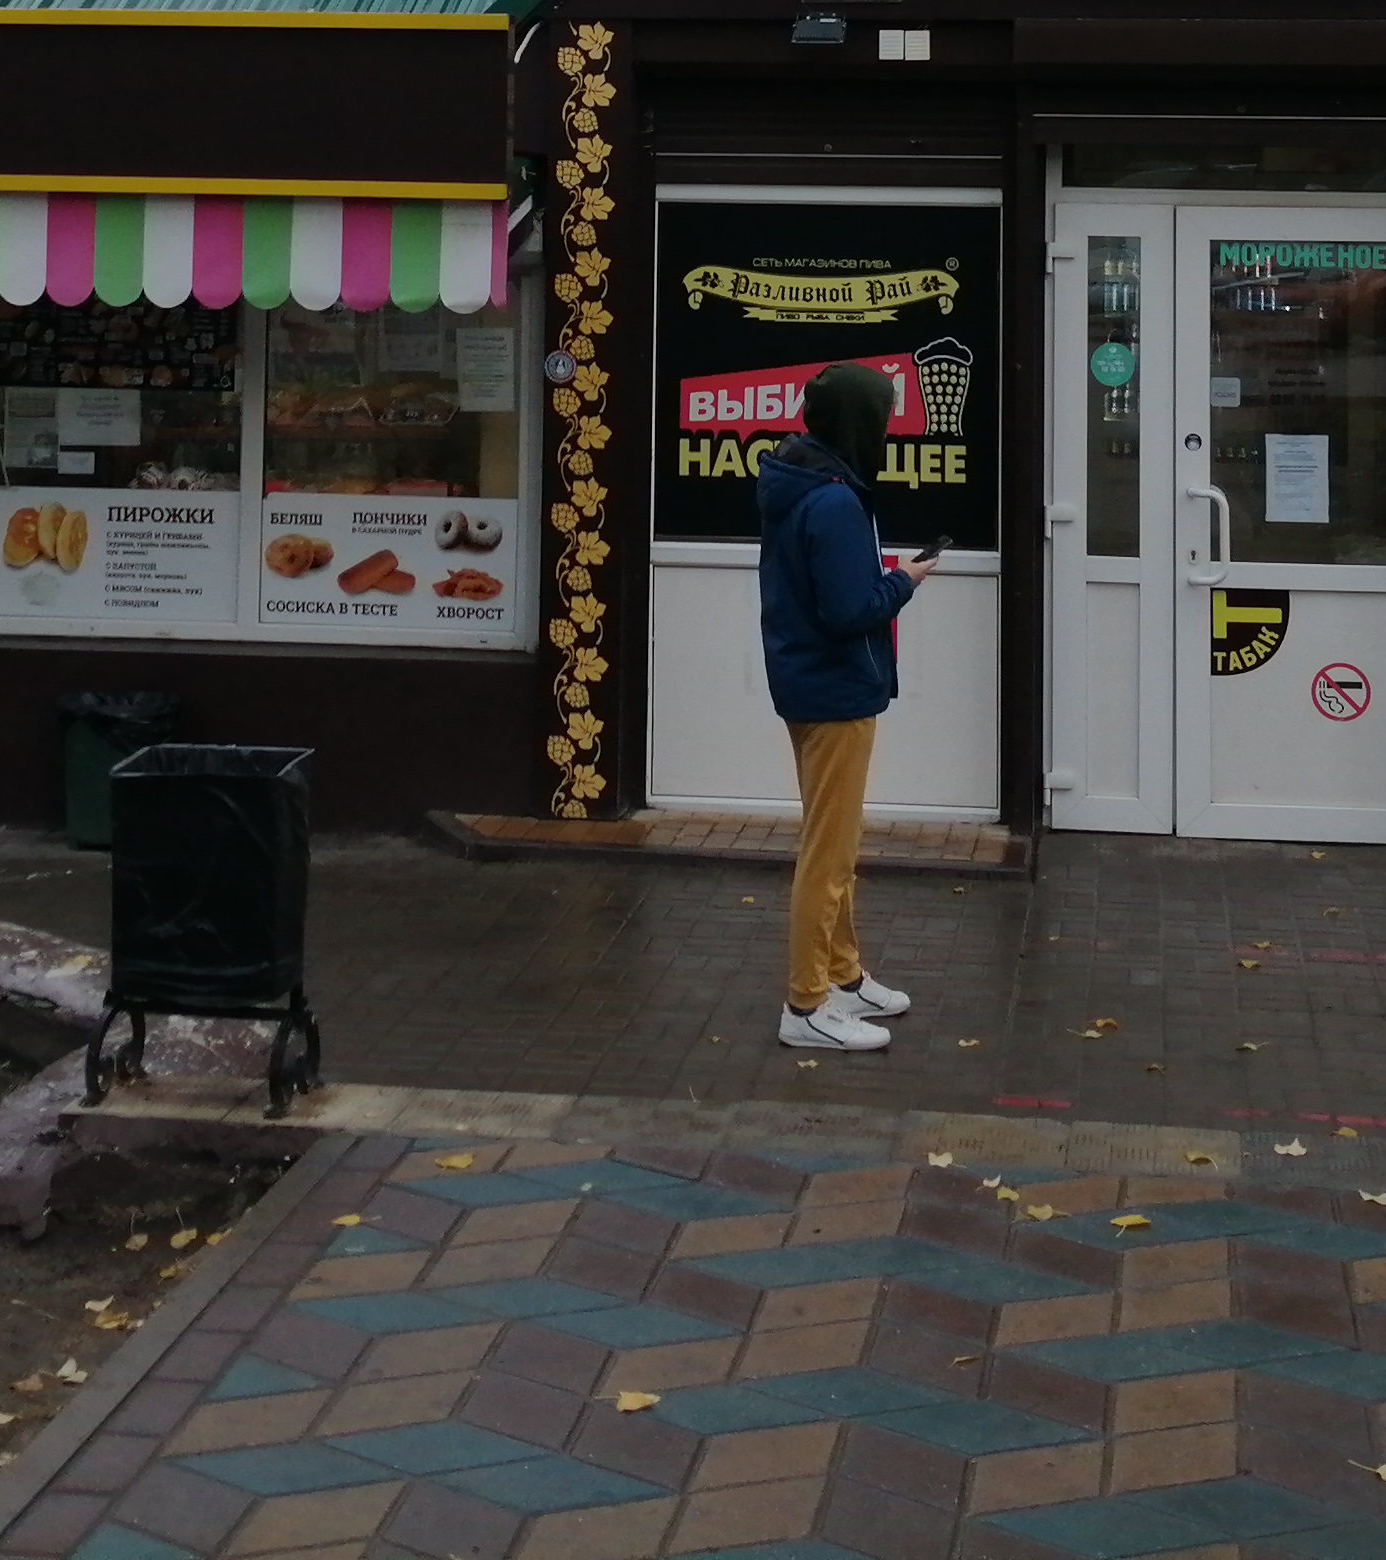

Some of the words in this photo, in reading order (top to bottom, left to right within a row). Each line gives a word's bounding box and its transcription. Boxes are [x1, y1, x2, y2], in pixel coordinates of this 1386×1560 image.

[752, 257, 783, 268] СЕТЬ
[784, 257, 856, 270] МАГАЗИНОВ
[859, 259, 892, 270] ПИВА
[727, 272, 854, 303] Разливной
[865, 275, 913, 305] Рай
[688, 363, 906, 422] ВЫБИЙ
[678, 438, 967, 489] НАСЩЕЕ
[107, 506, 215, 525] ПИРОЖКИ
[269, 512, 323, 526] БЕЛЯШ
[352, 511, 428, 527] ПОНЧИКИ
[266, 599, 336, 614] СОСИСКА
[339, 602, 348, 614] В
[351, 602, 398, 616] ТЕСТЕ
[436, 605, 505, 620] ХВОРОСТ
[1213, 626, 1280, 672] ТАБАК
